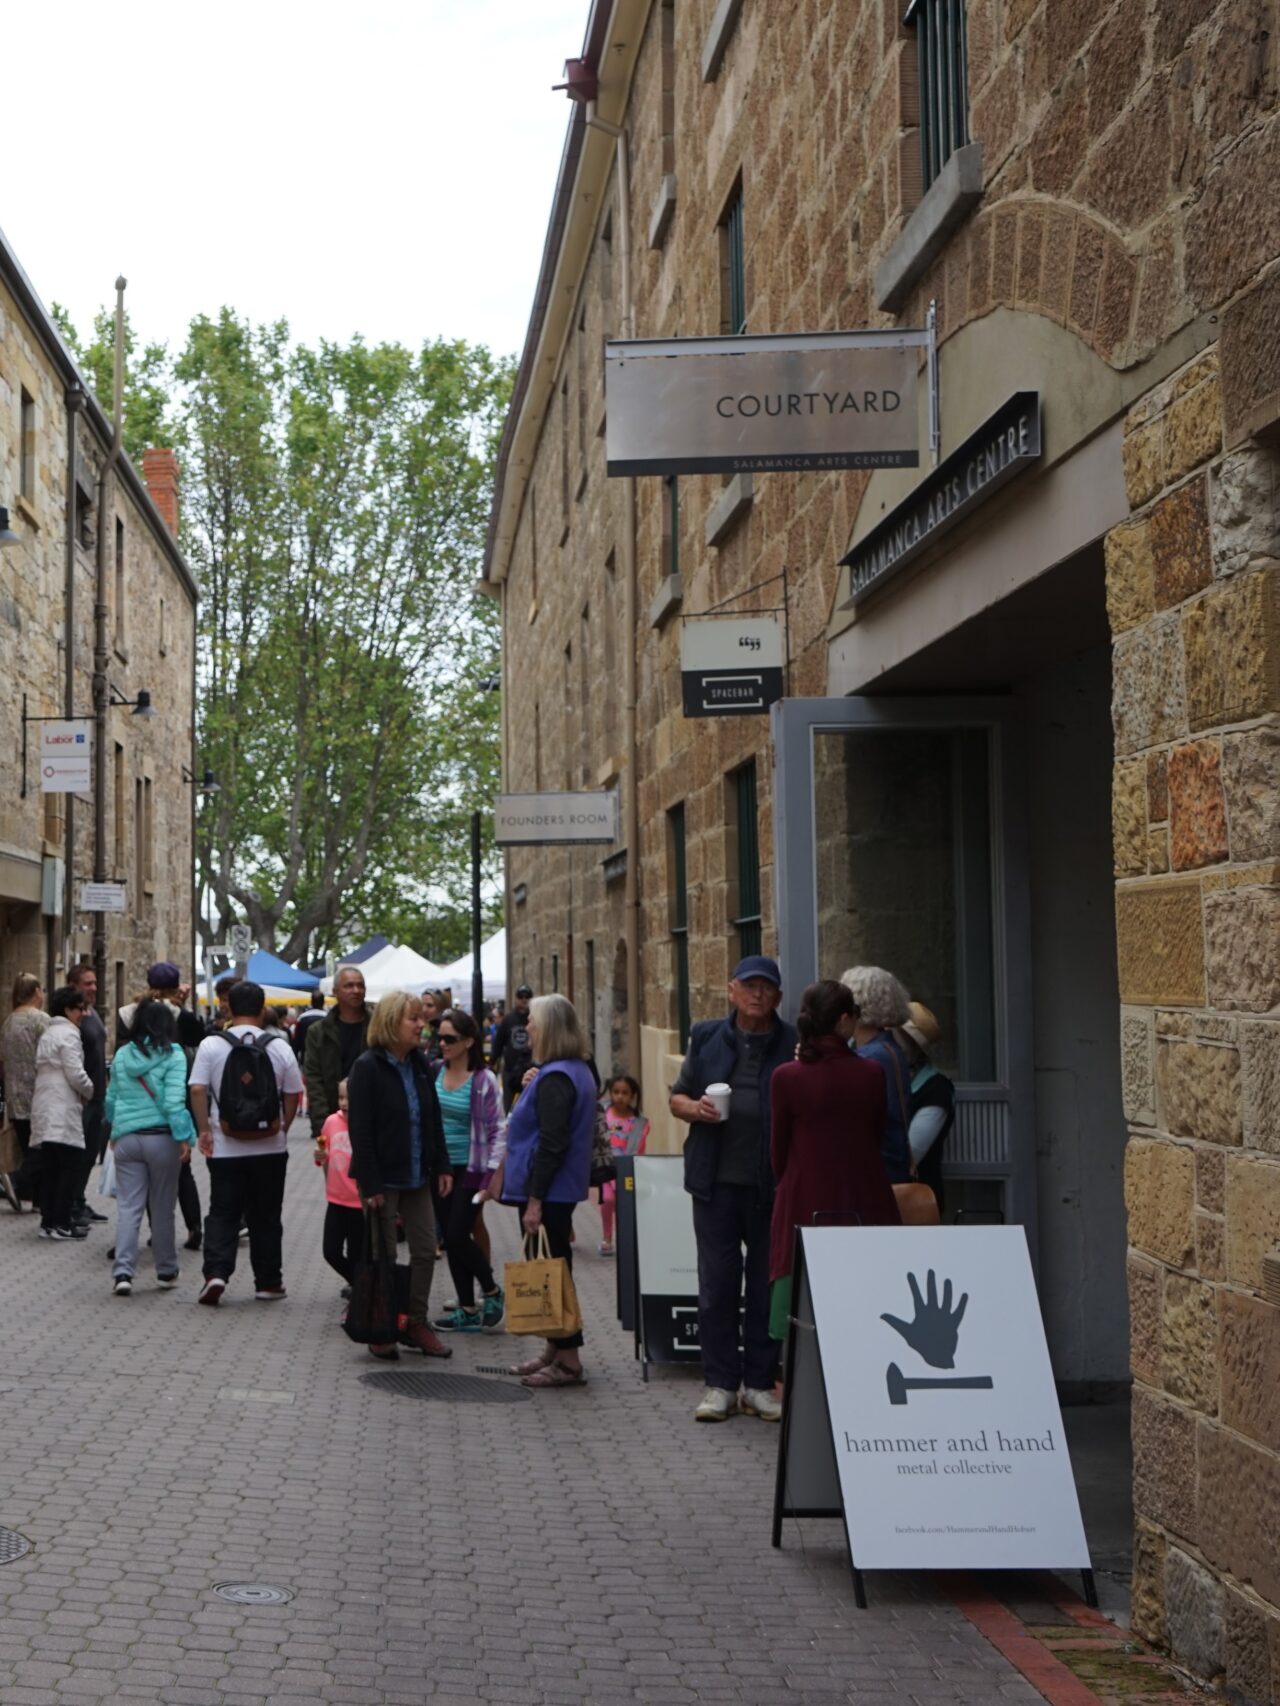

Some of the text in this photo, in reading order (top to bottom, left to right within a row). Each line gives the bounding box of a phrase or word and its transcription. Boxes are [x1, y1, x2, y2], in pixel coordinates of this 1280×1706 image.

[716, 390, 901, 418] COURTYARD
[733, 455, 902, 469] SALAMANCA ARTS CENTRE
[852, 415, 1029, 595] SALAMANCA ARTS CENTRE
[711, 687, 754, 698] SPACEBAR
[45, 735, 73, 745] Labor
[500, 813, 608, 826] FOUNDERS ROOM
[844, 1430, 1056, 1453] hammer and hand
[897, 1458, 1013, 1475] metal collective
